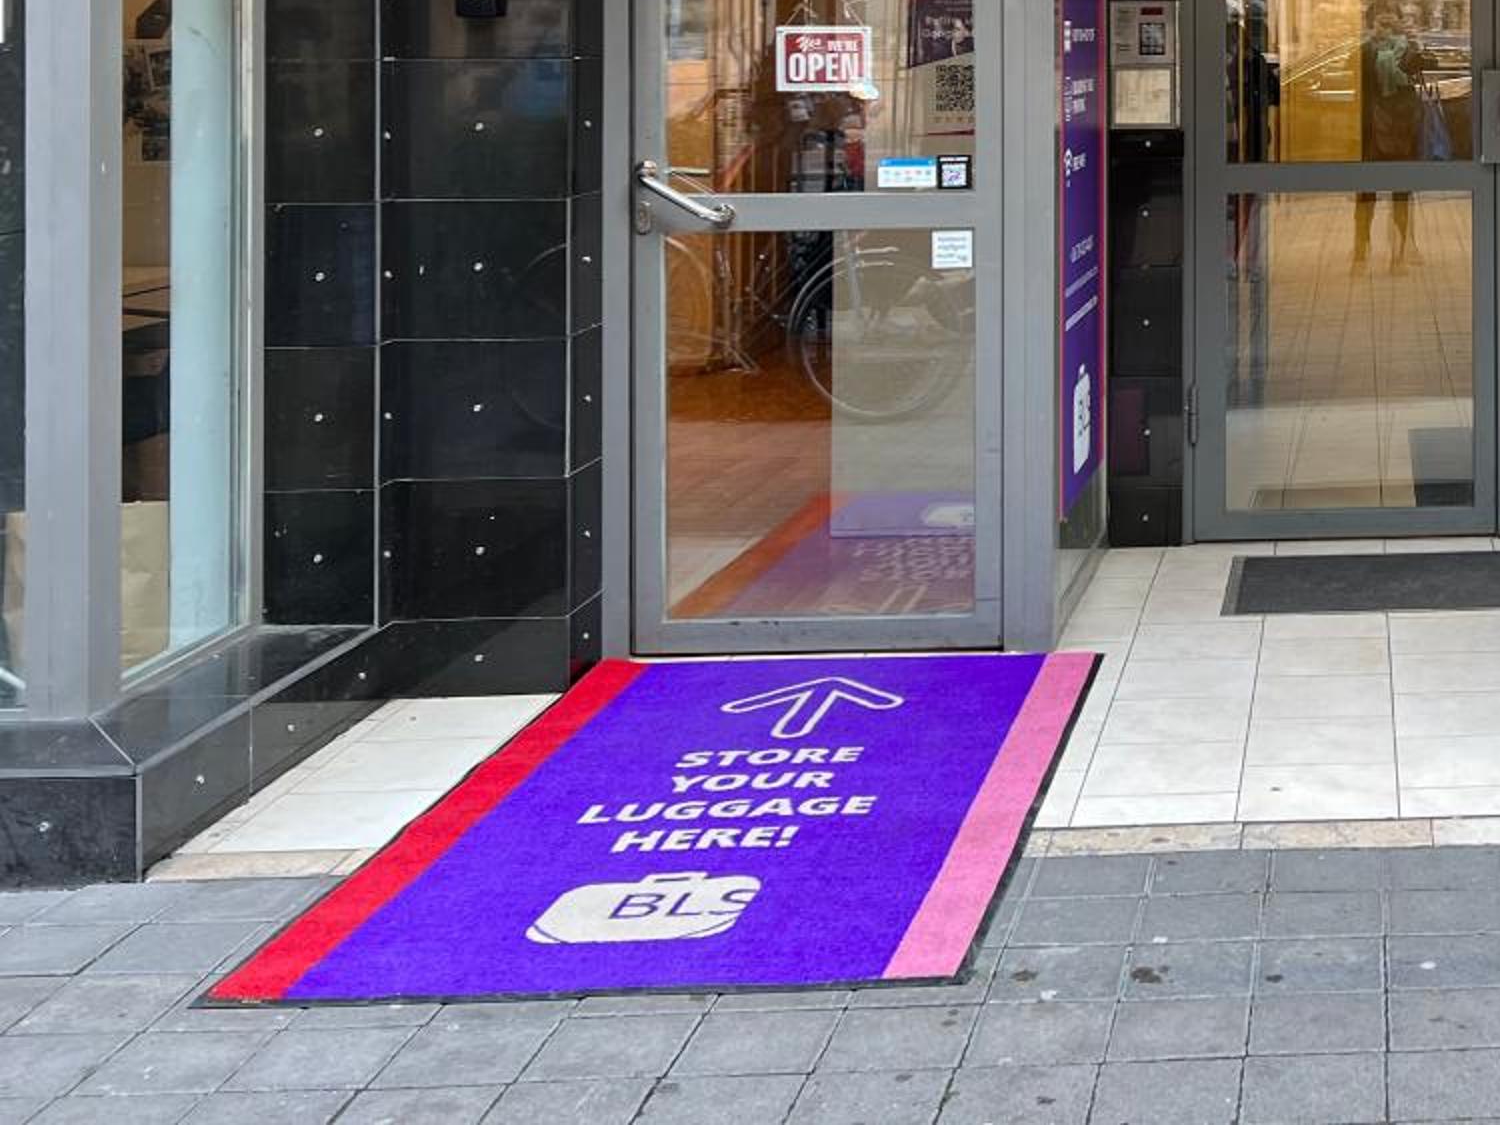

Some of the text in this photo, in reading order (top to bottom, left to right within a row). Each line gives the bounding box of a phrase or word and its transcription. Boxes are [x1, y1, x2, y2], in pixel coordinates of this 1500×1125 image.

[788, 52, 860, 82] OPEN
[675, 746, 864, 768] STORE
[672, 772, 835, 793] YOUR
[577, 796, 877, 824] LUGGAGE
[610, 826, 799, 854] HERE!
[608, 888, 757, 920] BLS
